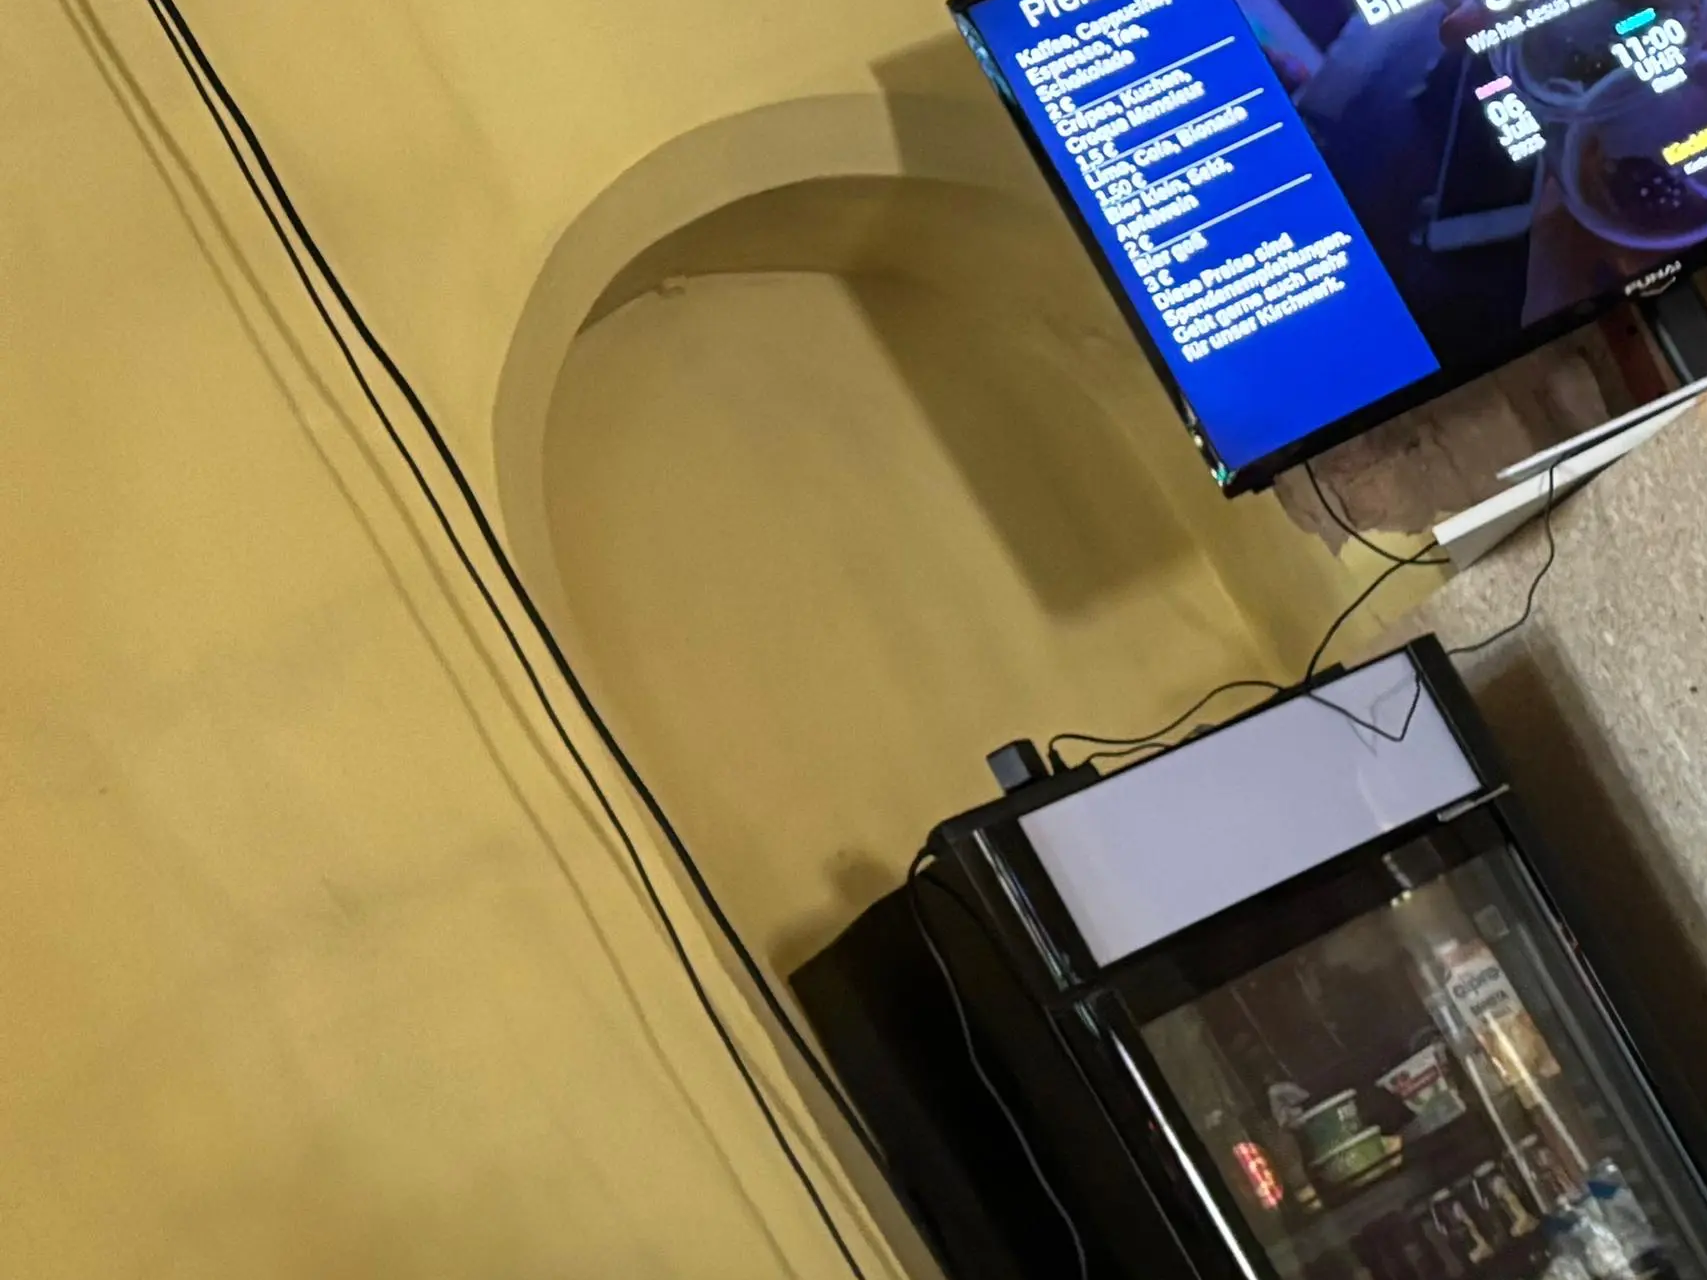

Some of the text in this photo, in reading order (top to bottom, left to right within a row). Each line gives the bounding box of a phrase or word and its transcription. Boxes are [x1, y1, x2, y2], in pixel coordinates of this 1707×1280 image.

[1611, 17, 1685, 68] 11:00
[1635, 45, 1684, 81] UHR
[1046, 103, 1061, 119] 2
[1485, 92, 1525, 127] 06
[1495, 112, 1539, 147] Juli
[1124, 242, 1139, 257] 2
[1144, 276, 1159, 292] 3
